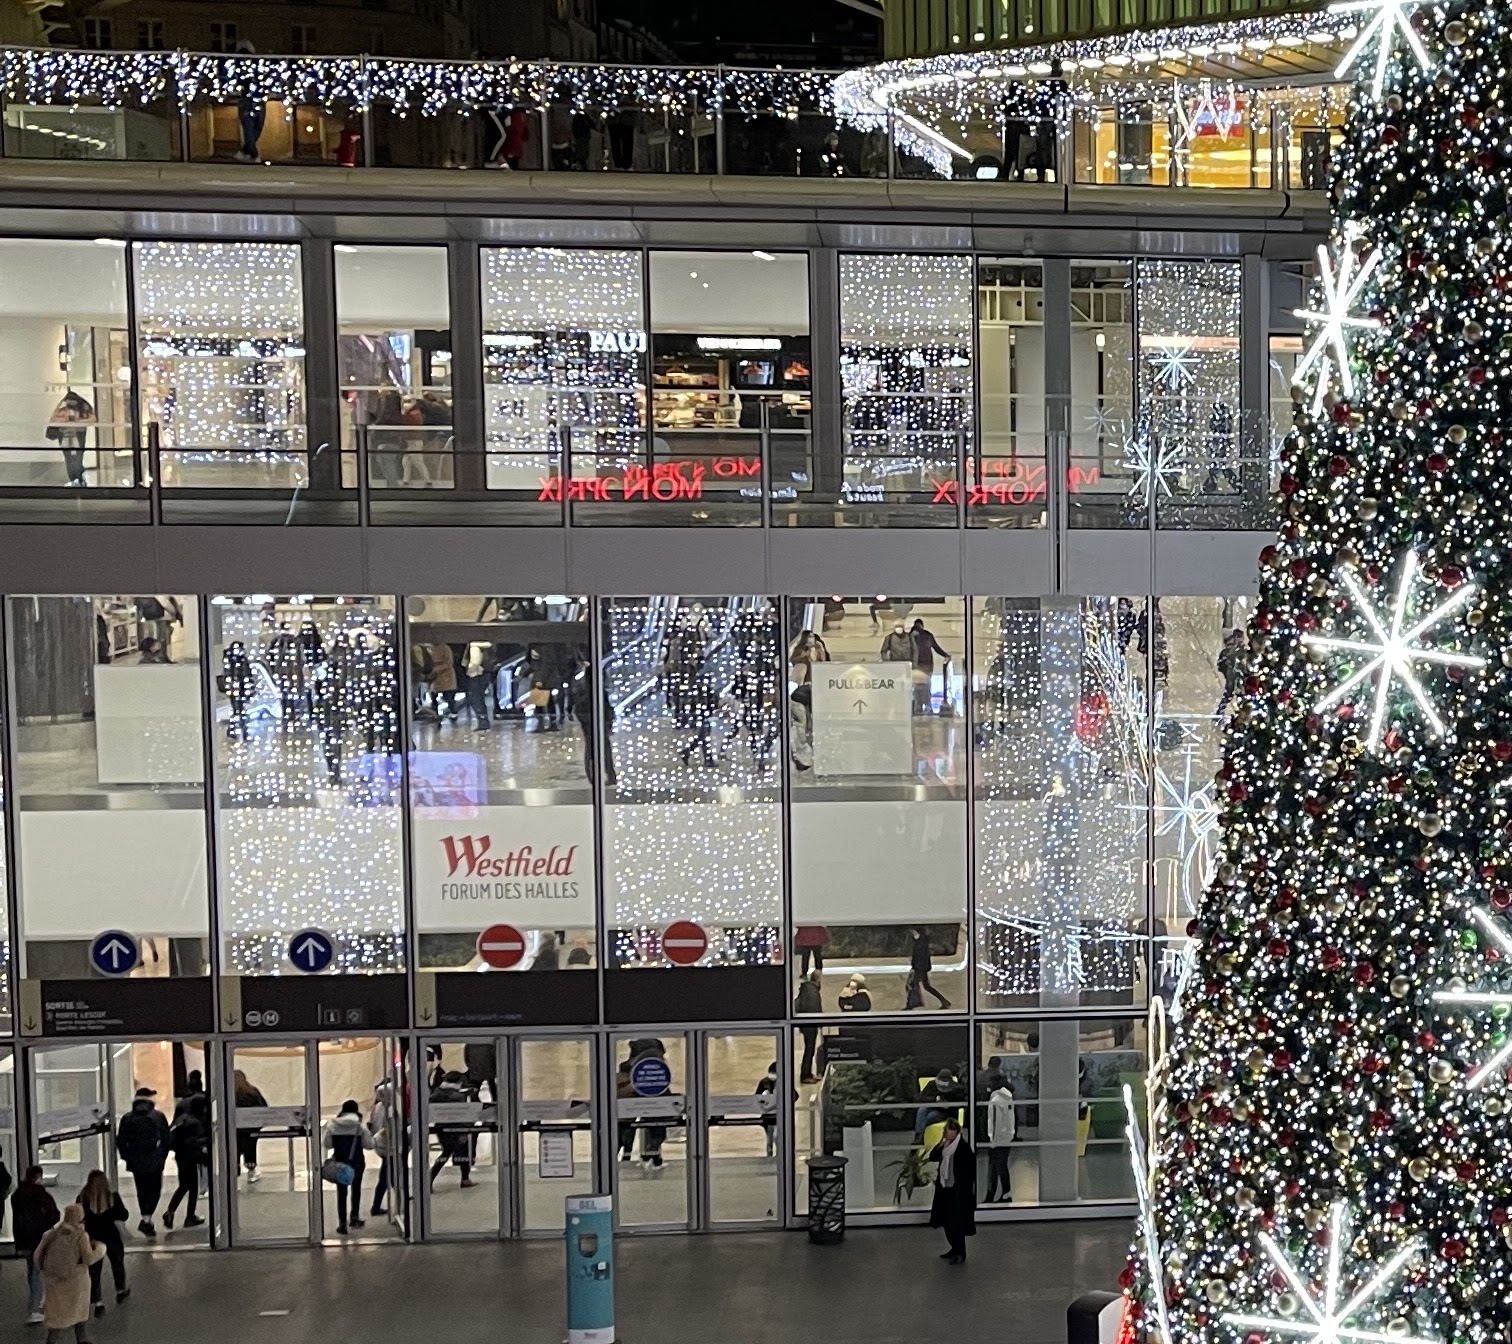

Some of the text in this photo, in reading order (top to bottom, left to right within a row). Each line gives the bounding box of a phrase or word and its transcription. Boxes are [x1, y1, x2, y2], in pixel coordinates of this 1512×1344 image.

[828, 679, 895, 690] PULL&BEAR
[439, 835, 579, 878] Westfield
[441, 881, 579, 900] FORUM DES HALLES
